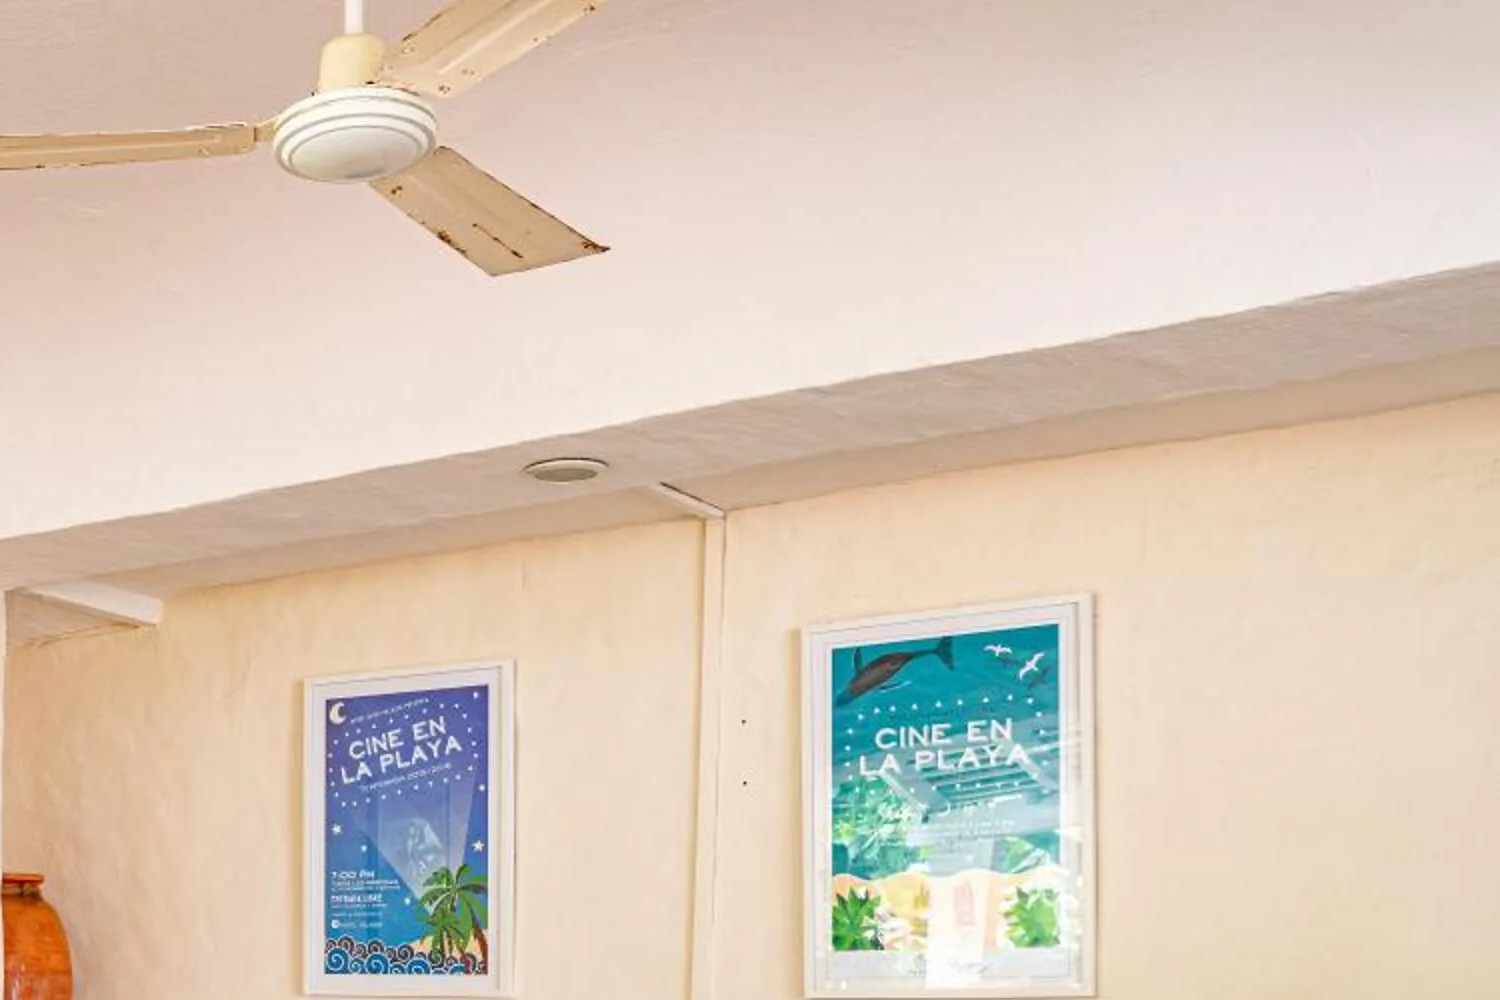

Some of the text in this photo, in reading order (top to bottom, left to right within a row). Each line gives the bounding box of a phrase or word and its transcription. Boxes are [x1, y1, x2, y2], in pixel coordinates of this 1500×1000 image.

[349, 715, 447, 760] CINE EN
[875, 717, 1014, 749] CINE EN
[340, 761, 372, 784] LA
[380, 735, 463, 773] PLAYA
[859, 743, 1030, 776] LA PLAYA
